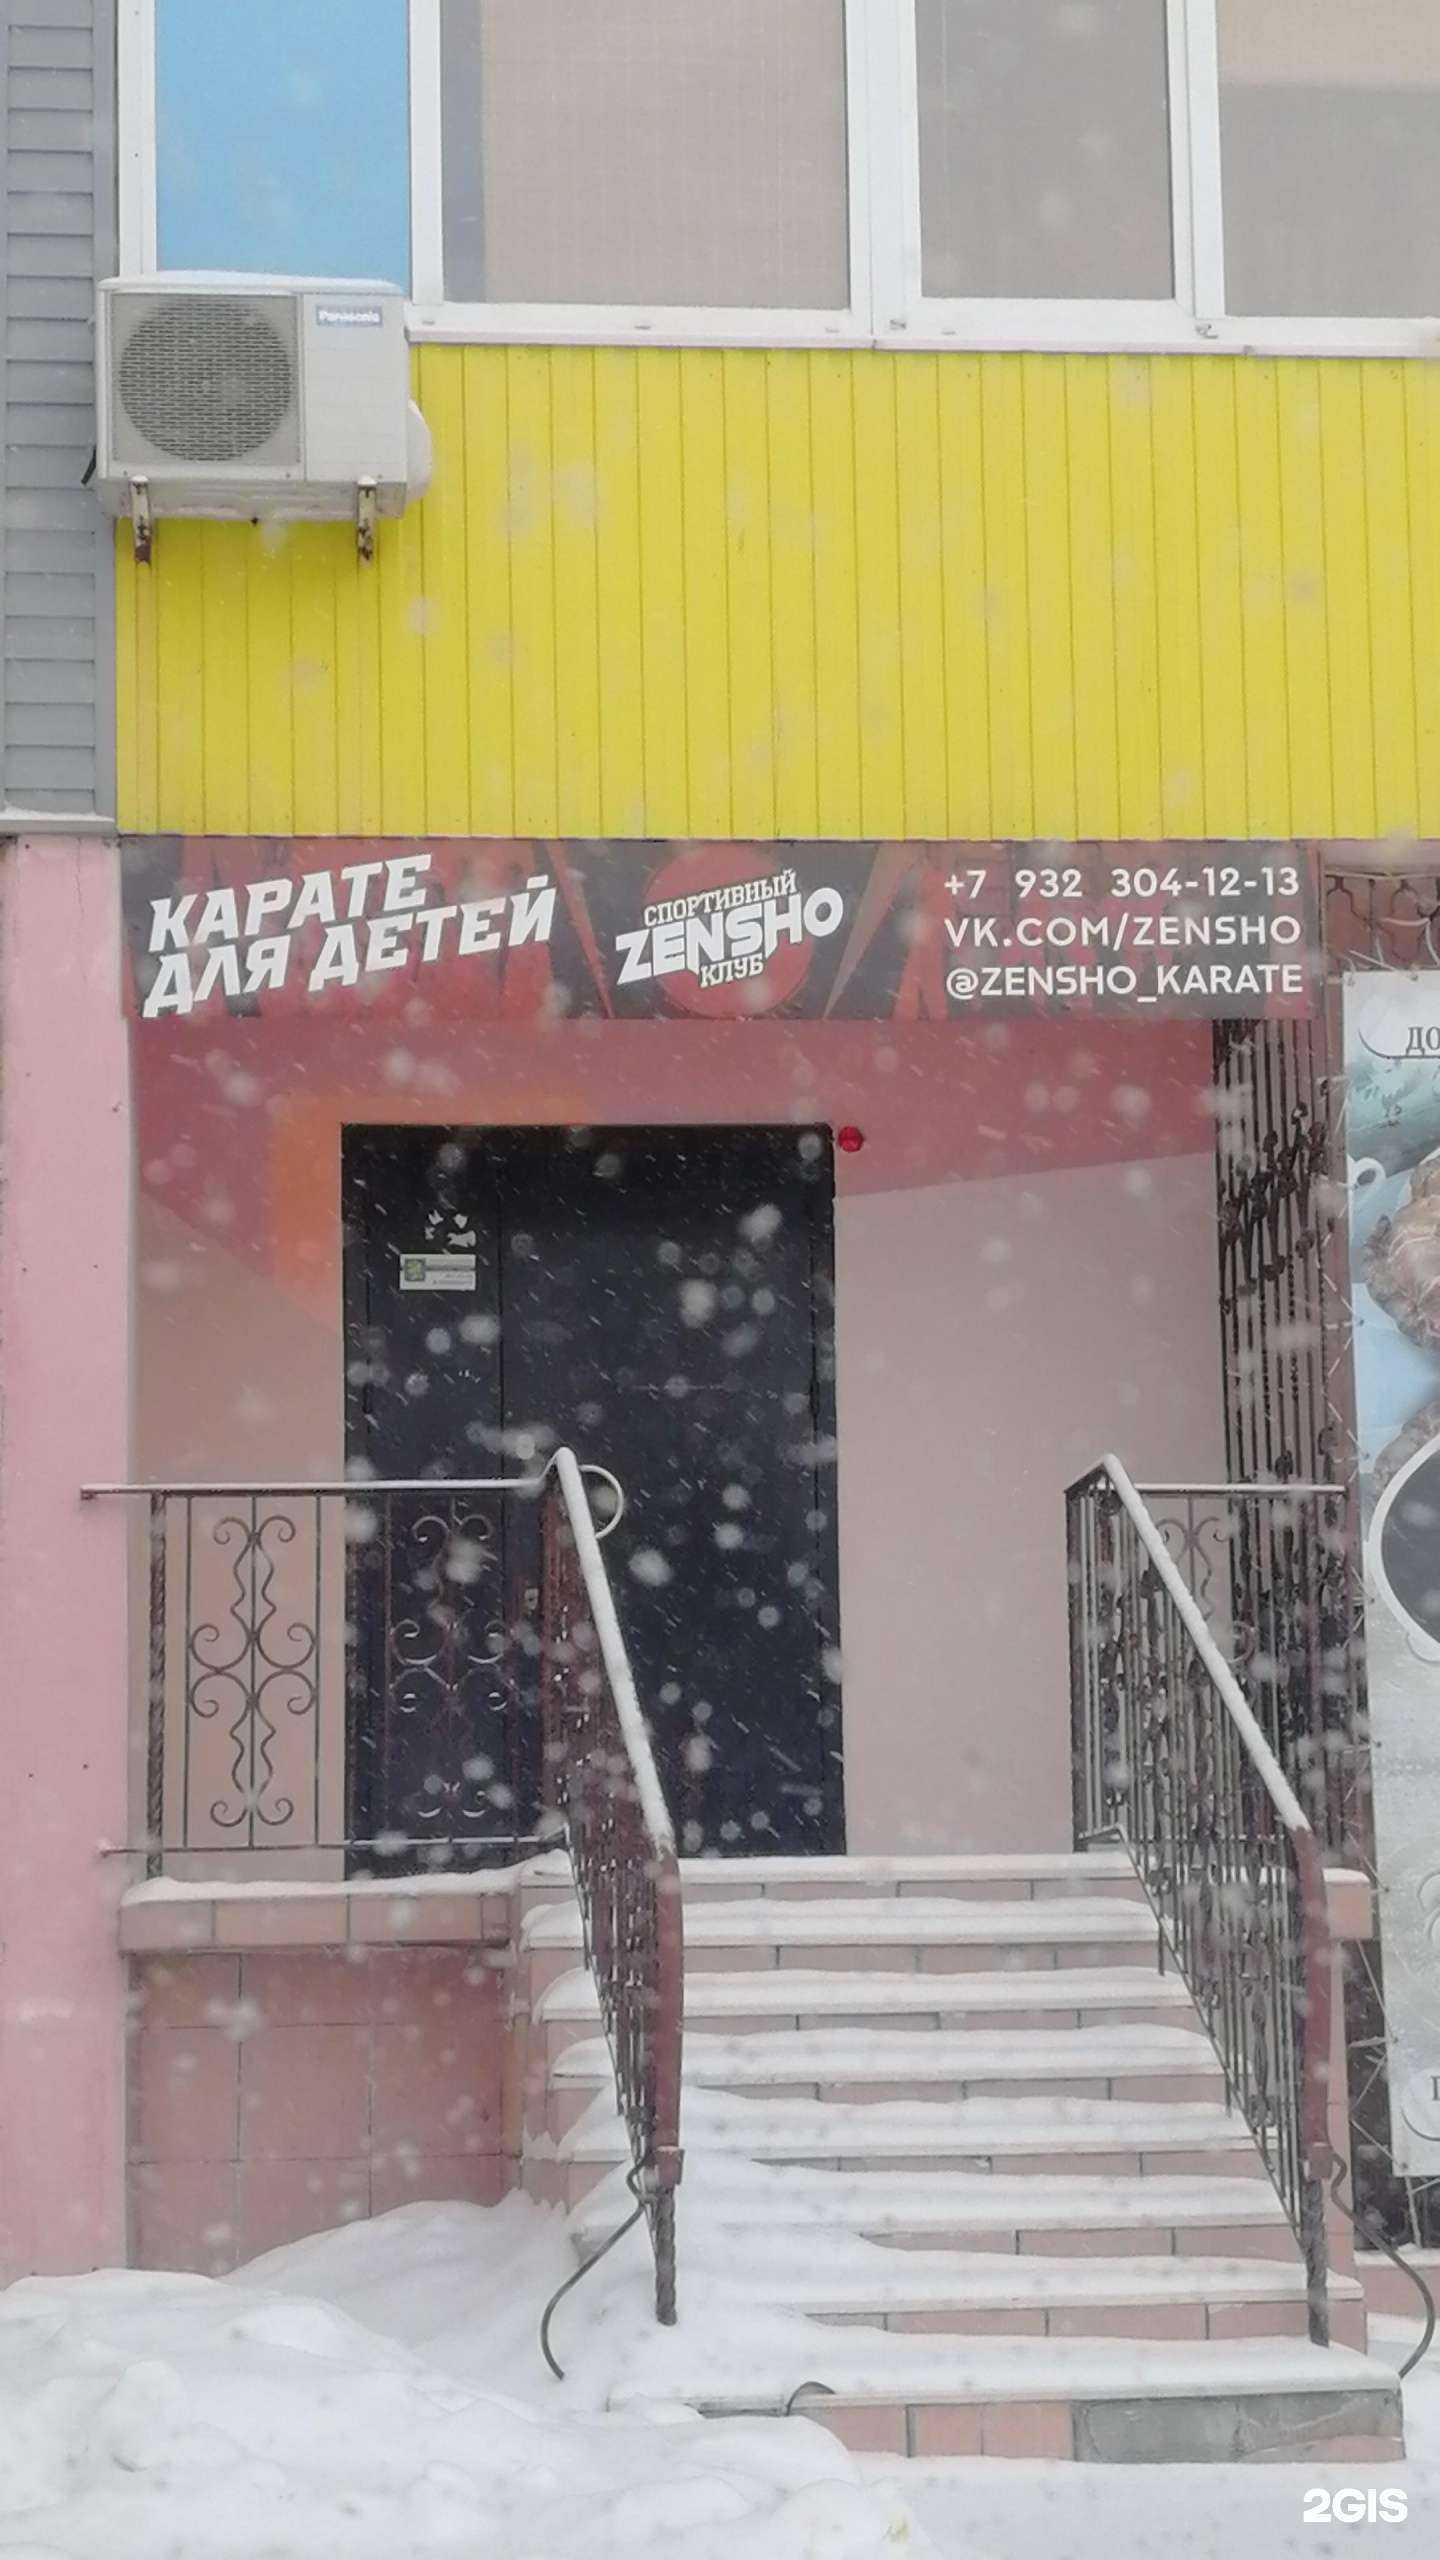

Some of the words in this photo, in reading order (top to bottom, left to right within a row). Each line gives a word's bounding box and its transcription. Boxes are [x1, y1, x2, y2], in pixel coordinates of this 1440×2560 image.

[149, 854, 431, 952] КАРАТЕ
[643, 868, 798, 927] СПОРТИВНЫЙ
[944, 869, 987, 899] +7
[1015, 869, 1083, 898] 932
[1110, 866, 1300, 898] 304-12-13
[143, 935, 291, 1018] ДЛЯ
[308, 874, 556, 992] ДЕТЕЙ
[615, 887, 844, 985] ZENSHO
[944, 913, 1301, 951] VK.COM/ZENSHO
[700, 952, 764, 988] КЛУБ
[945, 964, 1303, 1002] @ZENSHO_KARATE
